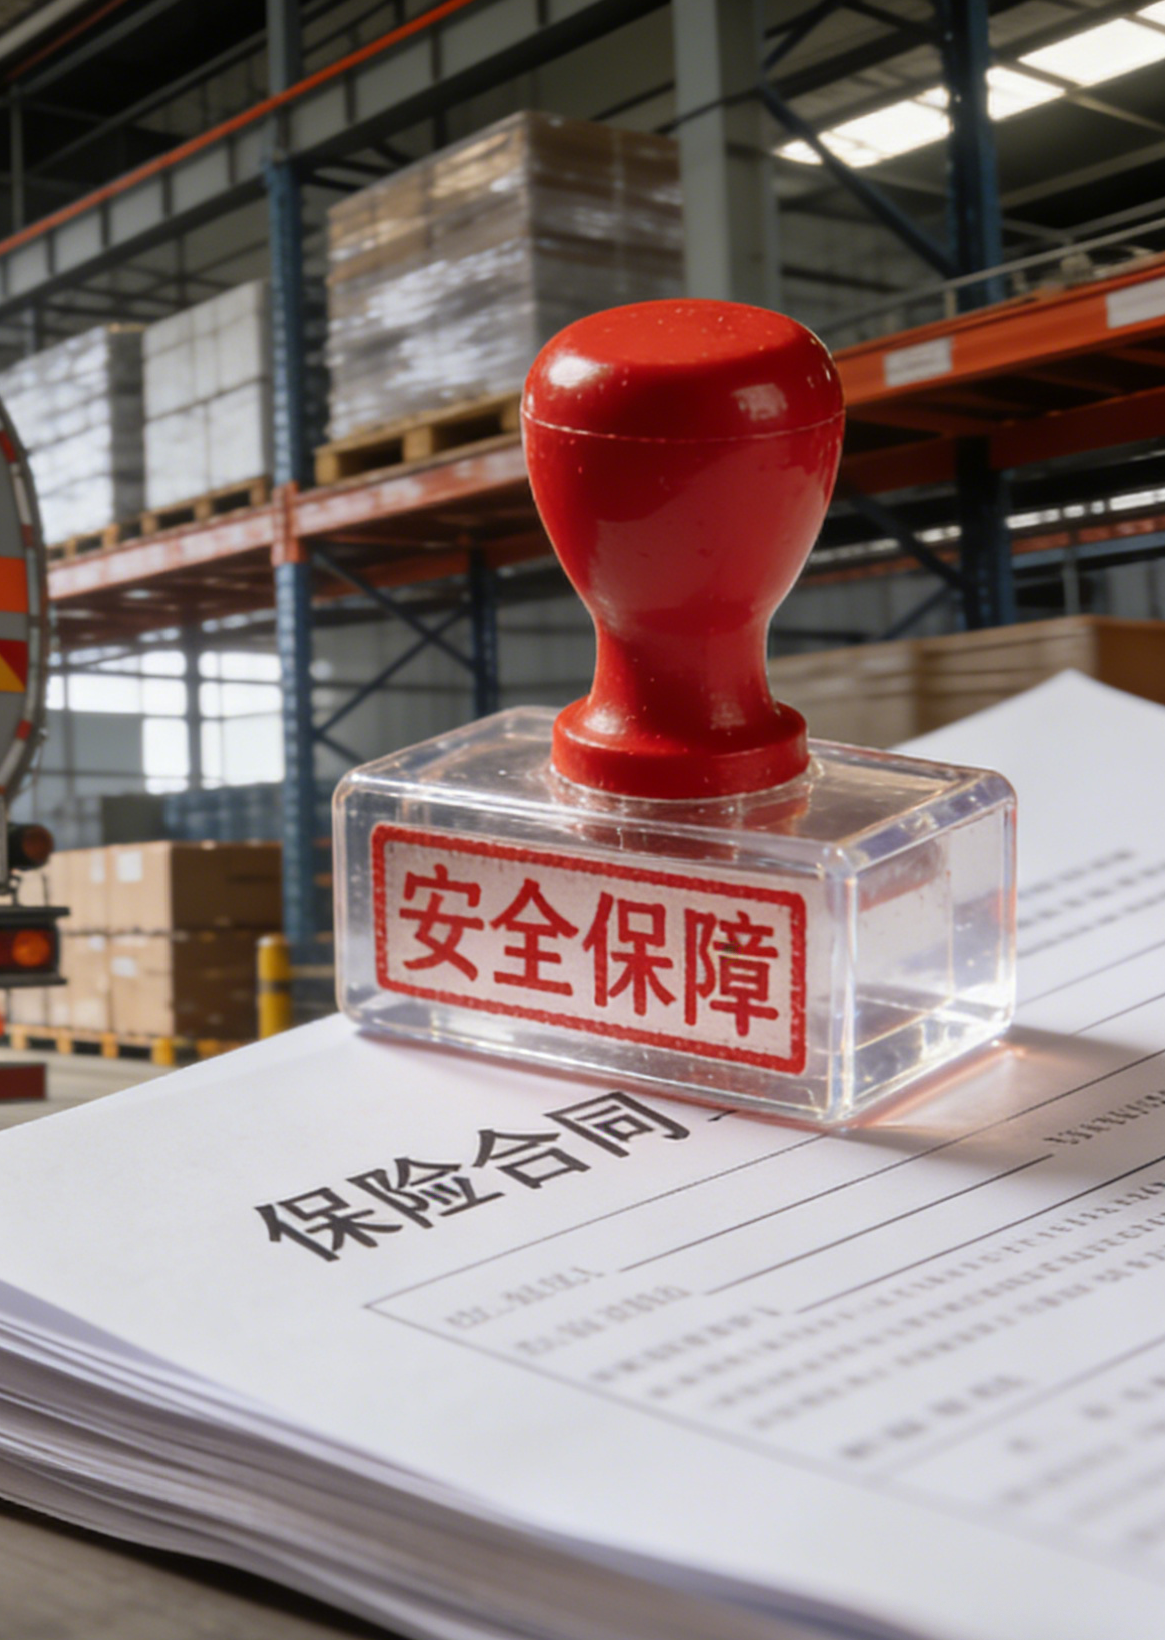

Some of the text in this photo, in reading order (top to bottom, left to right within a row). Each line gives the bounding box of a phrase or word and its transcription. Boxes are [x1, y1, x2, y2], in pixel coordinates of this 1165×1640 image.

[399, 864, 779, 1037] 安全保障
[253, 1091, 690, 1262] 保险合同
